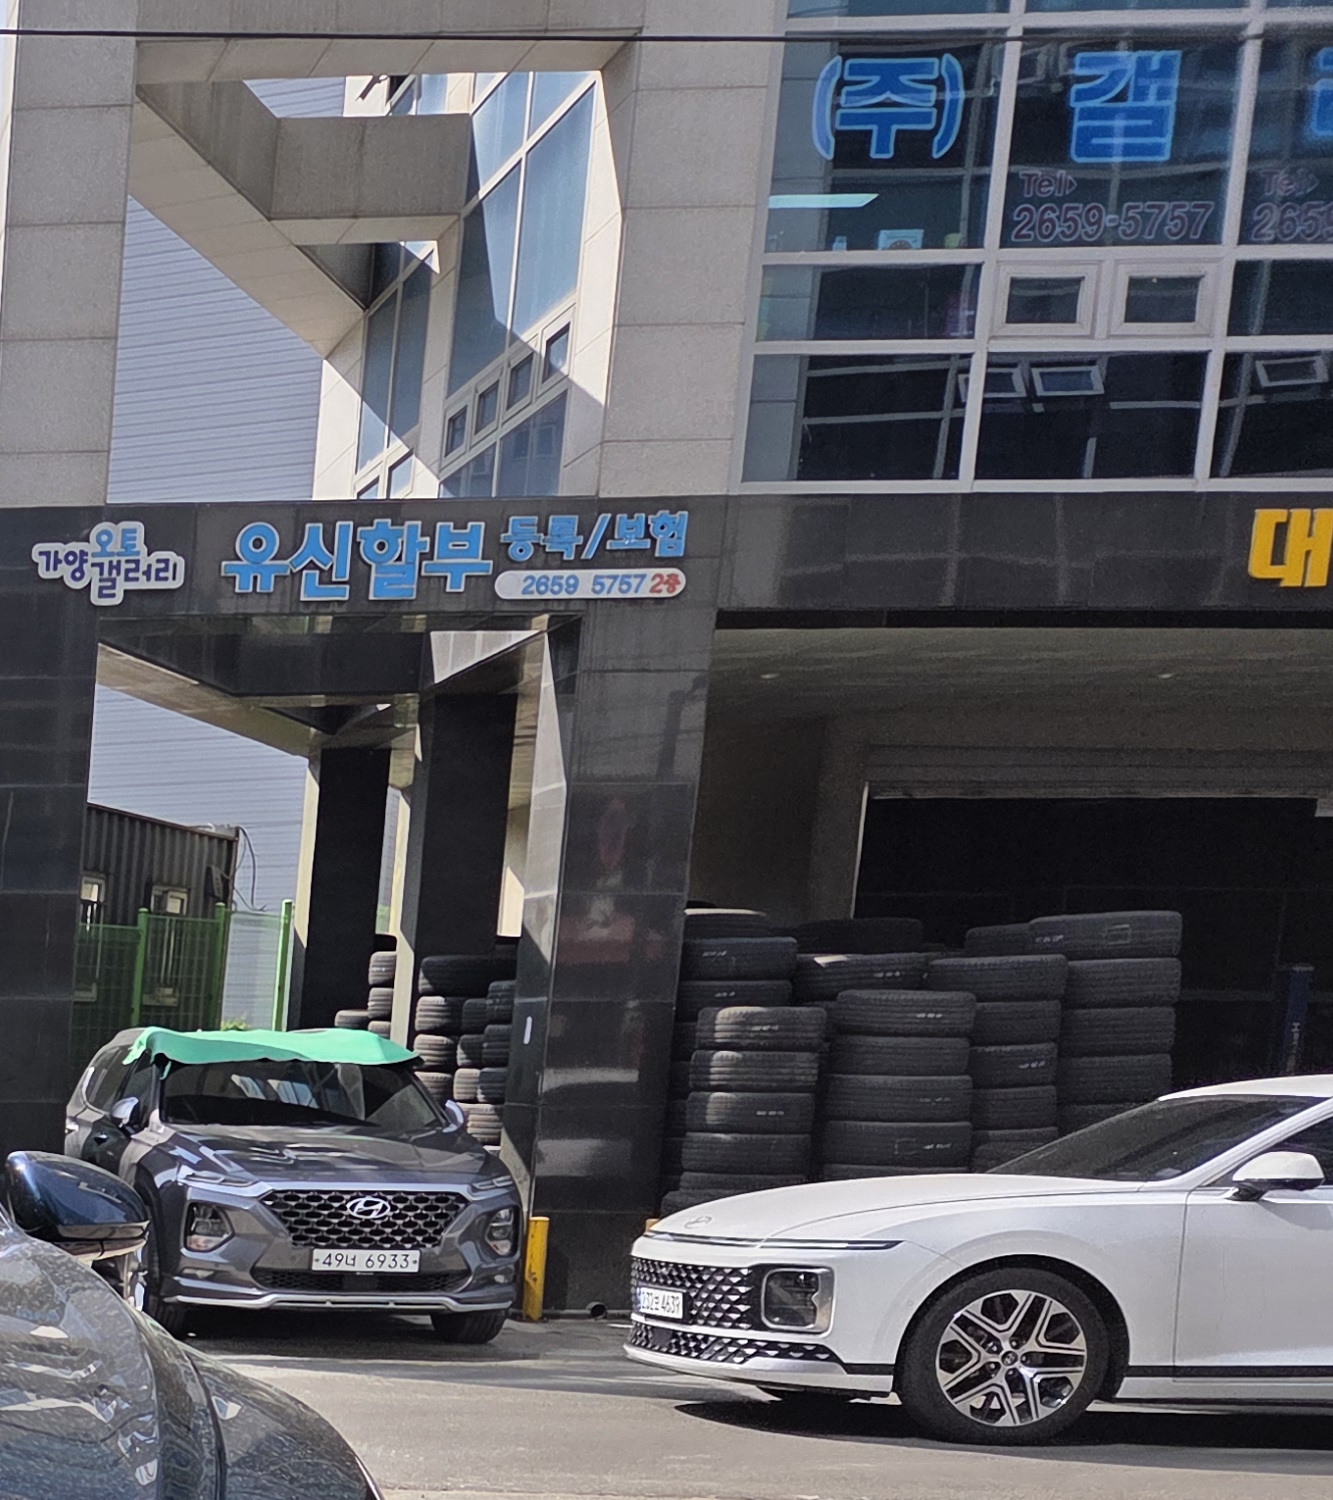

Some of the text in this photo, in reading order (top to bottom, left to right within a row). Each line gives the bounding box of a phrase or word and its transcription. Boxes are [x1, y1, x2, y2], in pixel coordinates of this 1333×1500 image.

[812, 53, 965, 160] (주)
[1019, 169, 1067, 197] Tel
[1011, 201, 1216, 242] 2659-5757
[91, 528, 141, 558] 오토
[500, 510, 689, 562] 등록/보험
[38, 550, 89, 582] 가양
[221, 518, 493, 601] 유신할부
[91, 557, 178, 599] 갤러리
[521, 573, 580, 596] 2659
[591, 572, 648, 595] 5757
[365, 1253, 410, 1269] 6933
